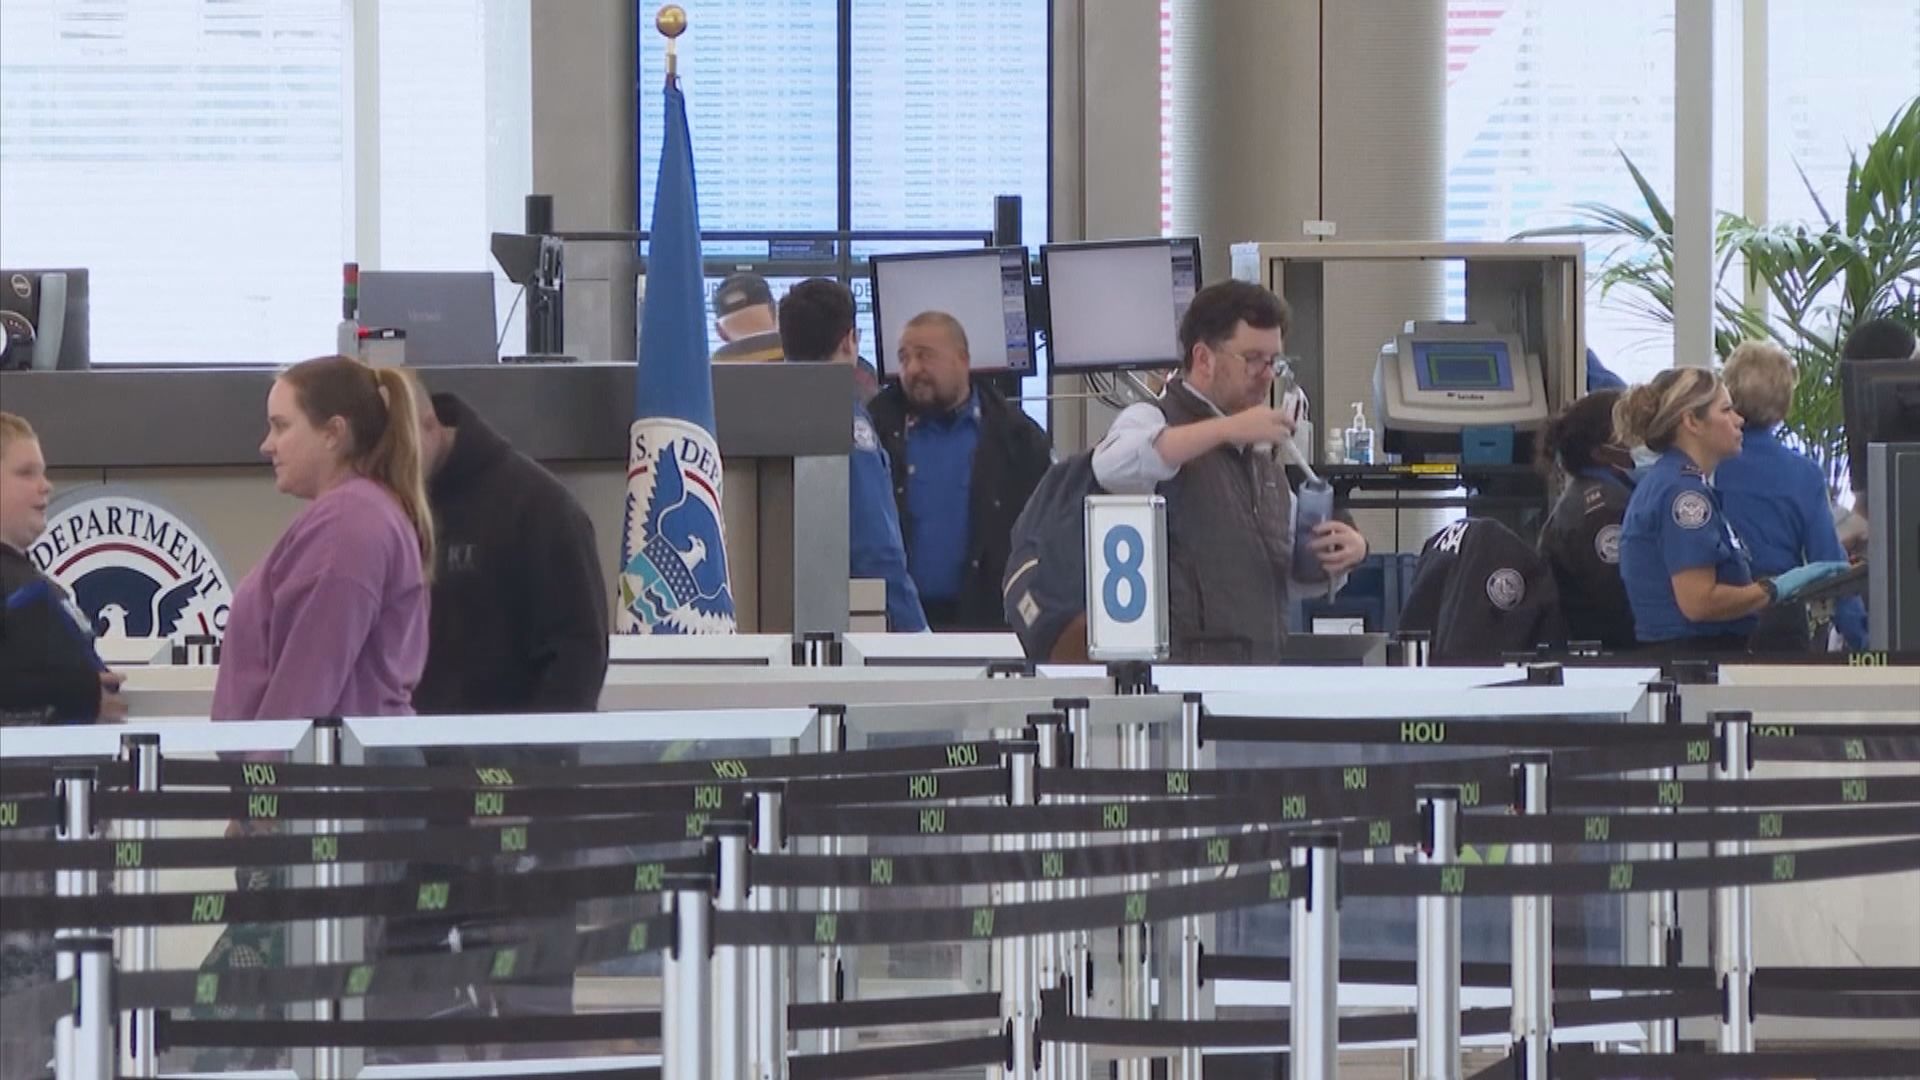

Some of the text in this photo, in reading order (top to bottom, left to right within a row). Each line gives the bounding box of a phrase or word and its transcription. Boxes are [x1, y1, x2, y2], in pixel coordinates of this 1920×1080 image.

[31, 505, 222, 600] DEPARTMENT
[1103, 524, 1147, 624] 8
[1848, 653, 1889, 667] HOU
[1401, 722, 1444, 743] HOU
[946, 745, 978, 767] HOU
[1687, 741, 1710, 761] HOU
[243, 764, 277, 786] HOU
[476, 768, 514, 785] HOU
[712, 761, 748, 778] HOU
[1344, 767, 1368, 789] HOU
[909, 776, 937, 798] HOU
[1167, 771, 1189, 793] HOU
[1659, 782, 1684, 804] HOU
[1842, 779, 1867, 801] HOU
[249, 794, 278, 818] HOU
[475, 793, 504, 814] HOU
[694, 787, 722, 808] HOU
[1283, 796, 1306, 818] HOU
[920, 810, 945, 833] HOU
[1103, 805, 1128, 829] HOU
[1585, 817, 1610, 840] HOU
[1759, 814, 1784, 838] HOU
[1369, 821, 1391, 845] HOU
[115, 842, 142, 867] HOU
[312, 837, 338, 861] HOU
[871, 858, 893, 885] HOU
[1042, 852, 1063, 877] HOU
[1773, 855, 1796, 879] HOU
[1441, 868, 1466, 892] HOU
[1610, 864, 1633, 889] HOU
[417, 883, 449, 910] HOU
[192, 895, 225, 922] HOU
